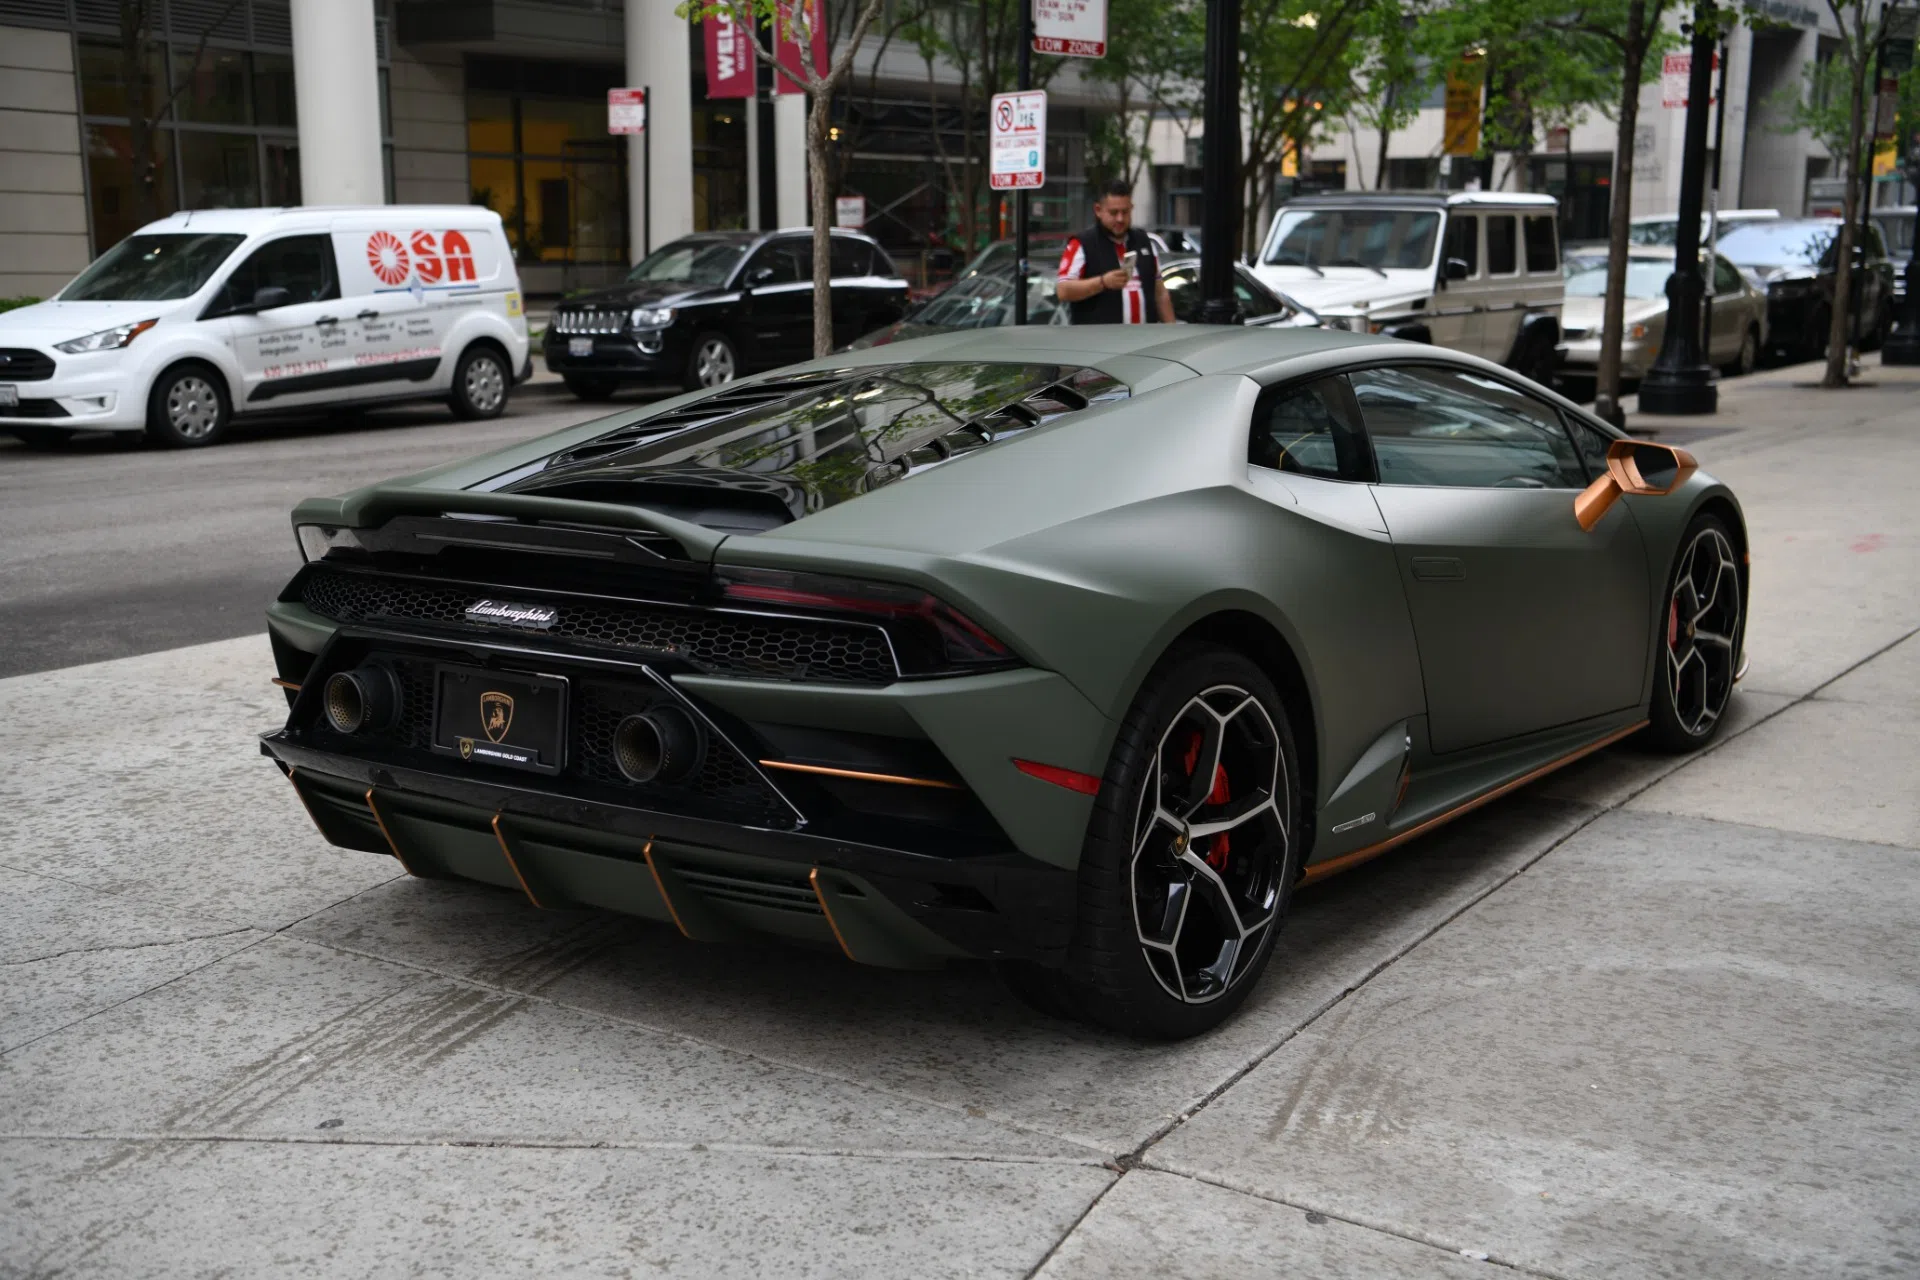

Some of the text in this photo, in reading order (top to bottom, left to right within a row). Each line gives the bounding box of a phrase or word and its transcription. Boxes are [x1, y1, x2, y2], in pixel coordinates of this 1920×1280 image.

[716, 0, 735, 81] WELC
[1038, 38, 1100, 55] TOW ZONE
[995, 172, 1039, 187] TOW ZONE
[366, 229, 477, 286] OSA
[464, 600, 555, 622] Lamborghini
[473, 748, 528, 763] LAMBORGHINI GOLD COAST
